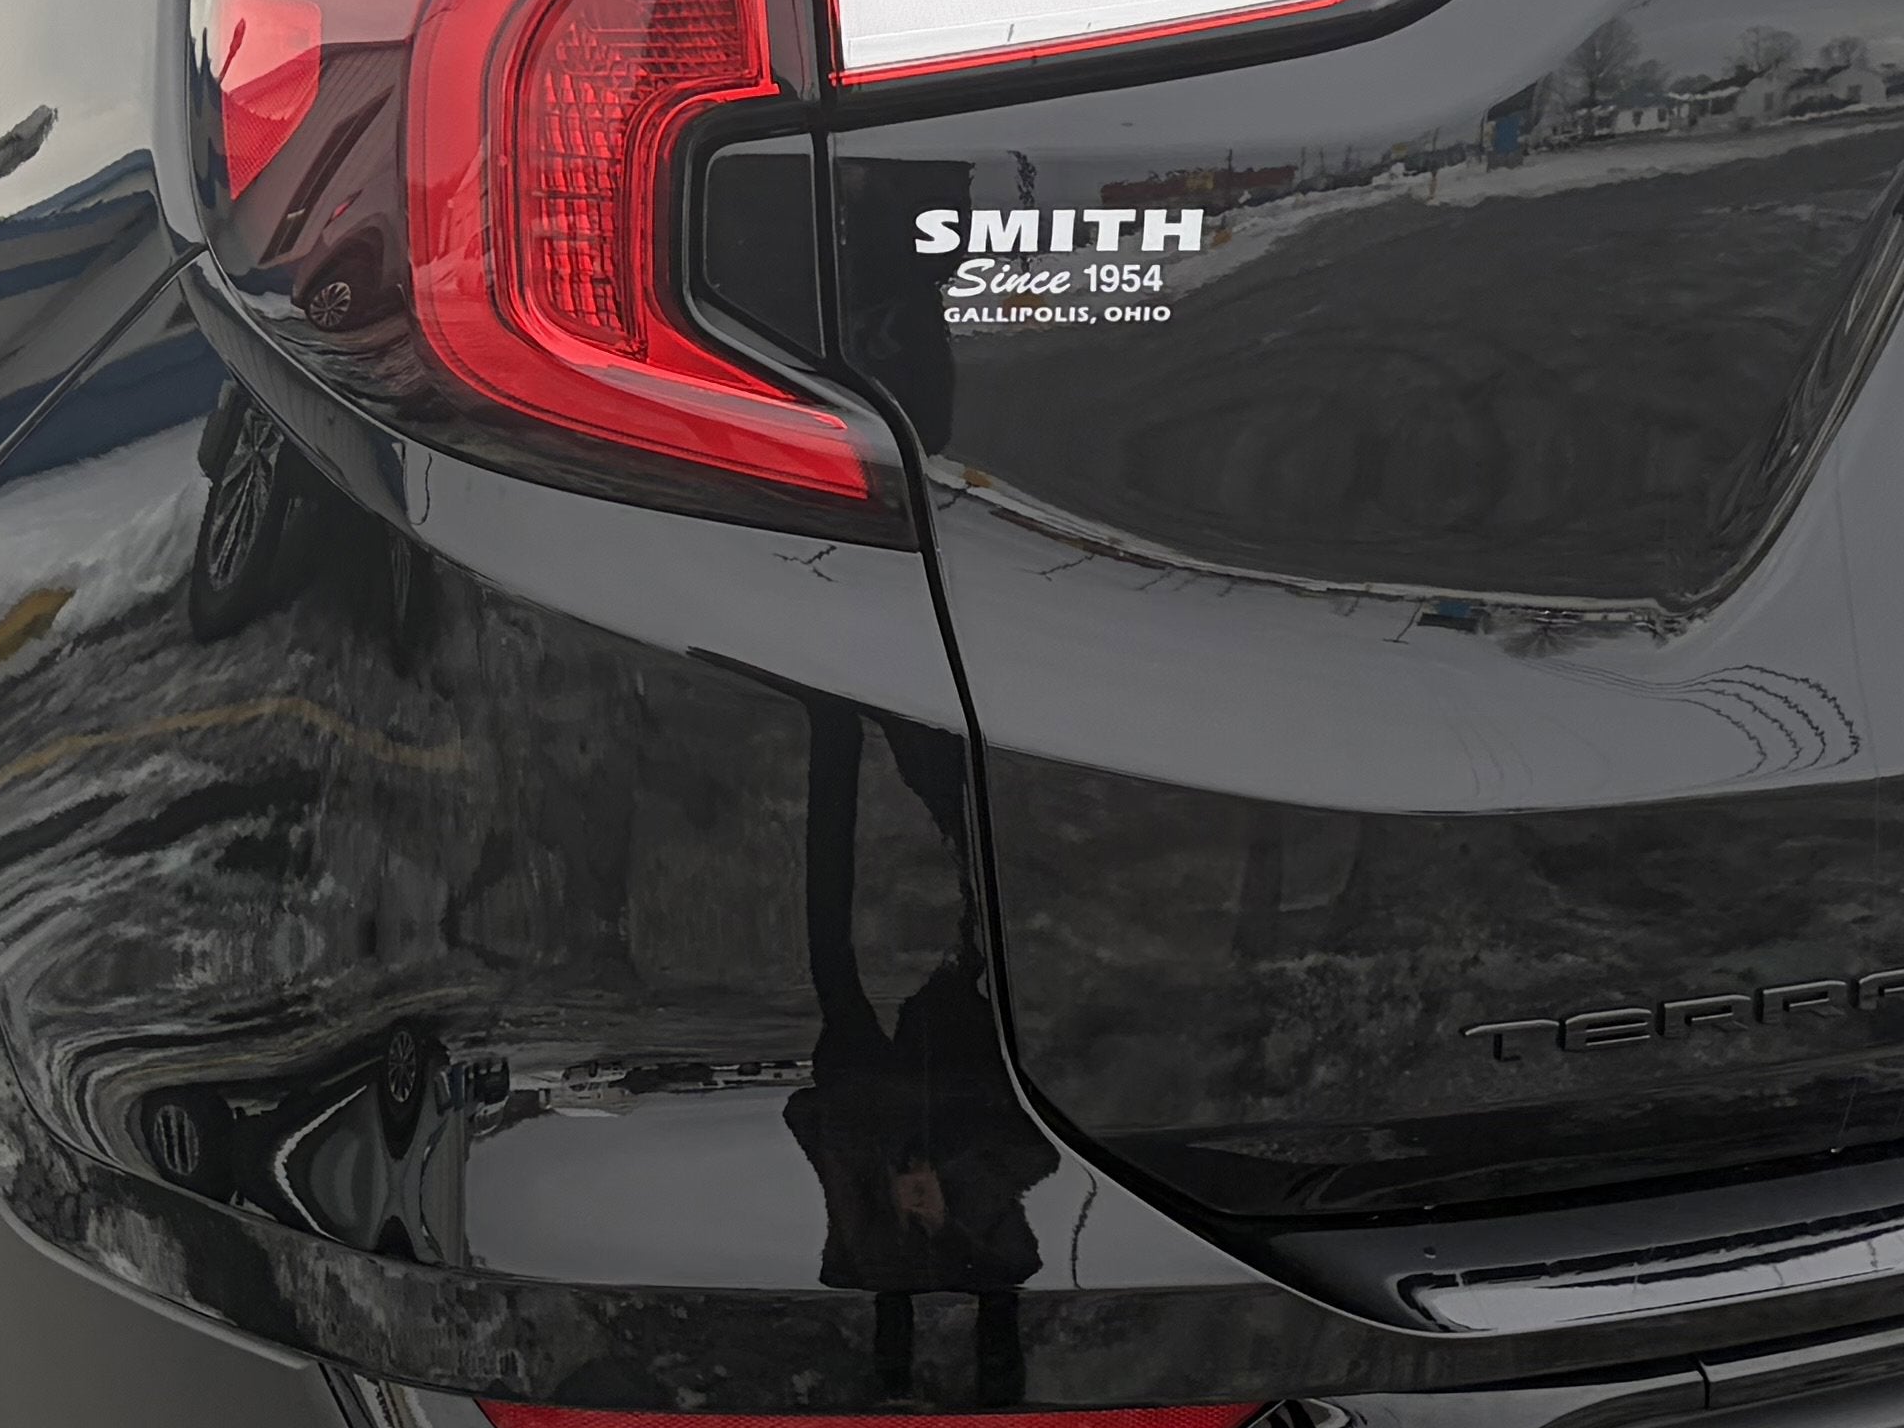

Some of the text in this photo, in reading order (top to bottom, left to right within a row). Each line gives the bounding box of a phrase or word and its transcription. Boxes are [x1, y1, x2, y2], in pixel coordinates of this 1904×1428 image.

[914, 208, 1205, 254] SMITH
[946, 257, 1164, 298] Since 1954
[943, 305, 1172, 325] GALLIPOLIS, OHIO
